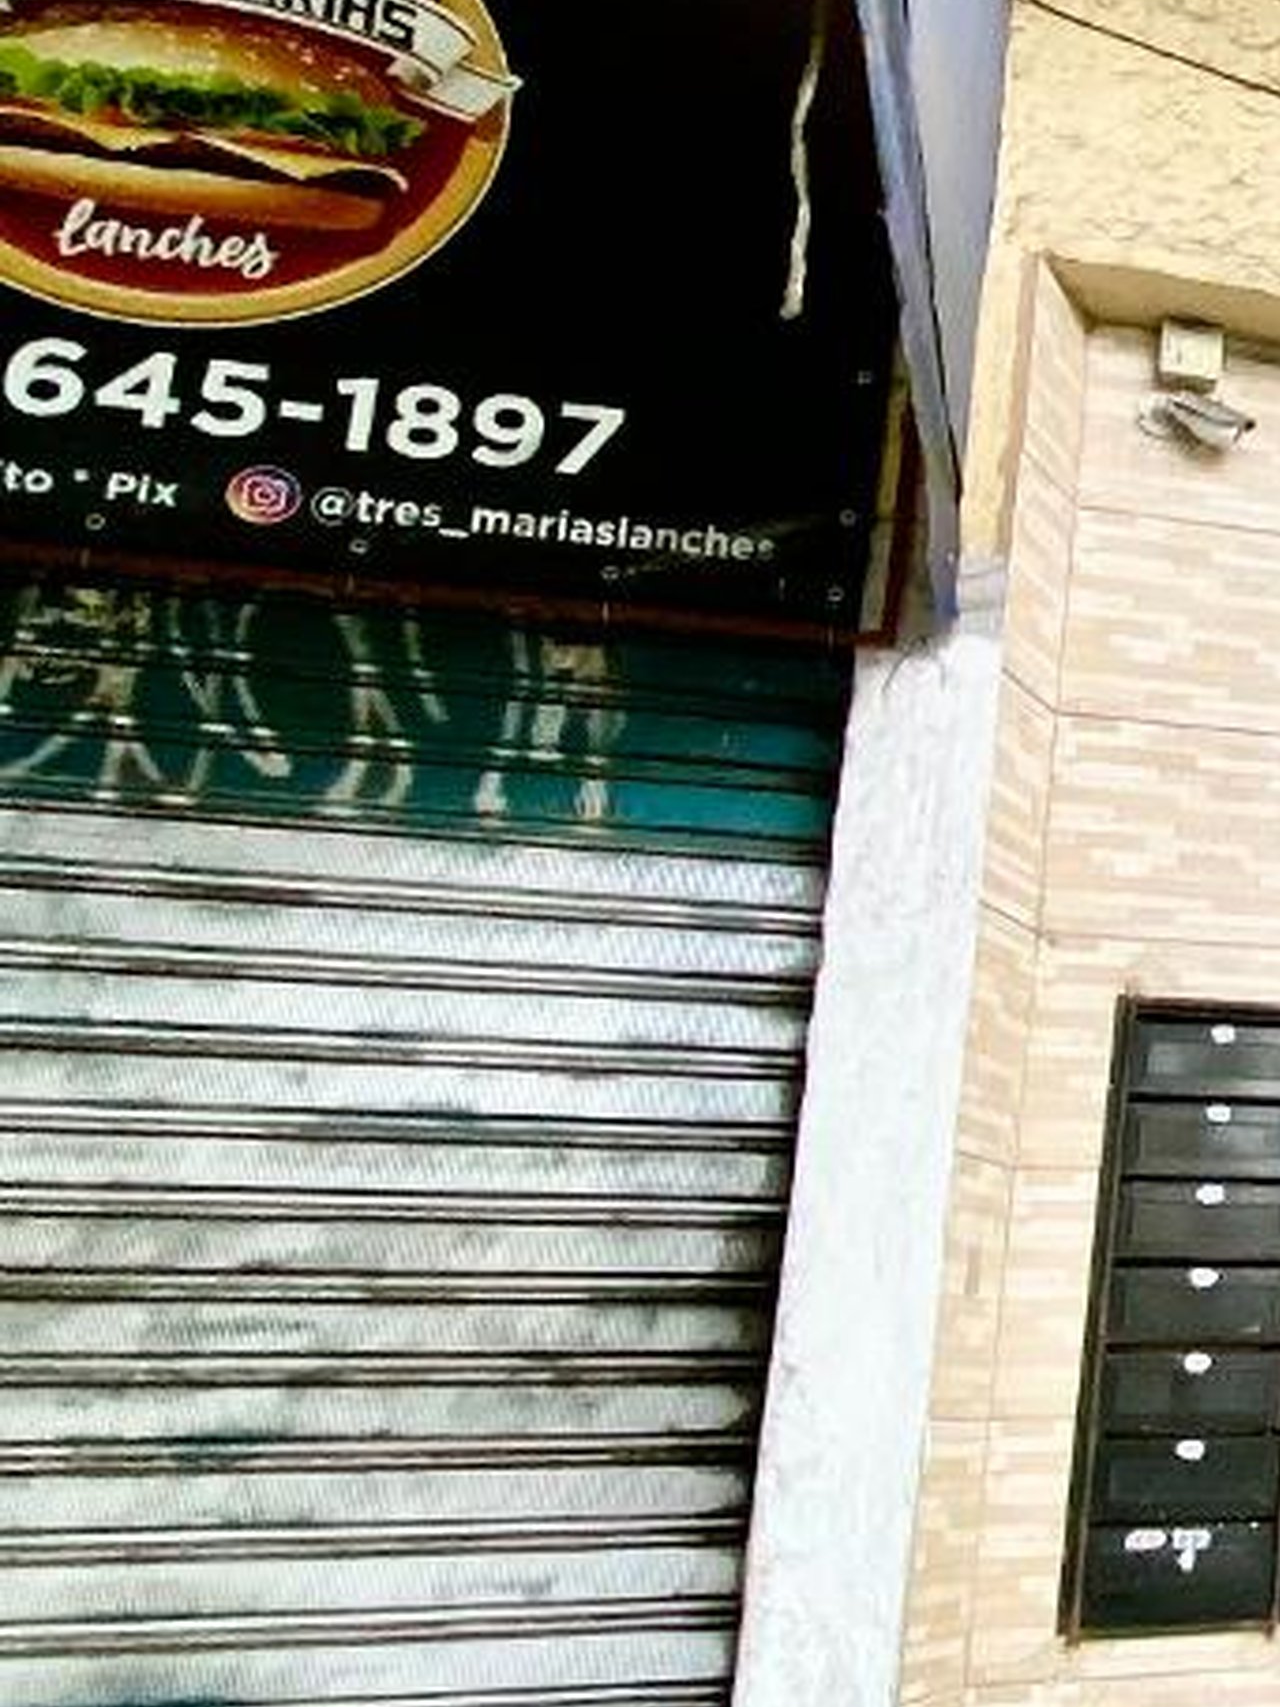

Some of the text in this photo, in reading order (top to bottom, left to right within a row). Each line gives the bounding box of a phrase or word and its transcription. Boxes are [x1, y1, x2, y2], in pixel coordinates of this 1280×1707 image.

[54, 197, 279, 280] lanches
[2, 336, 627, 476] 645-1897
[0, 459, 180, 508] to Pix
[310, 486, 776, 561] @tres_mariaslanches
